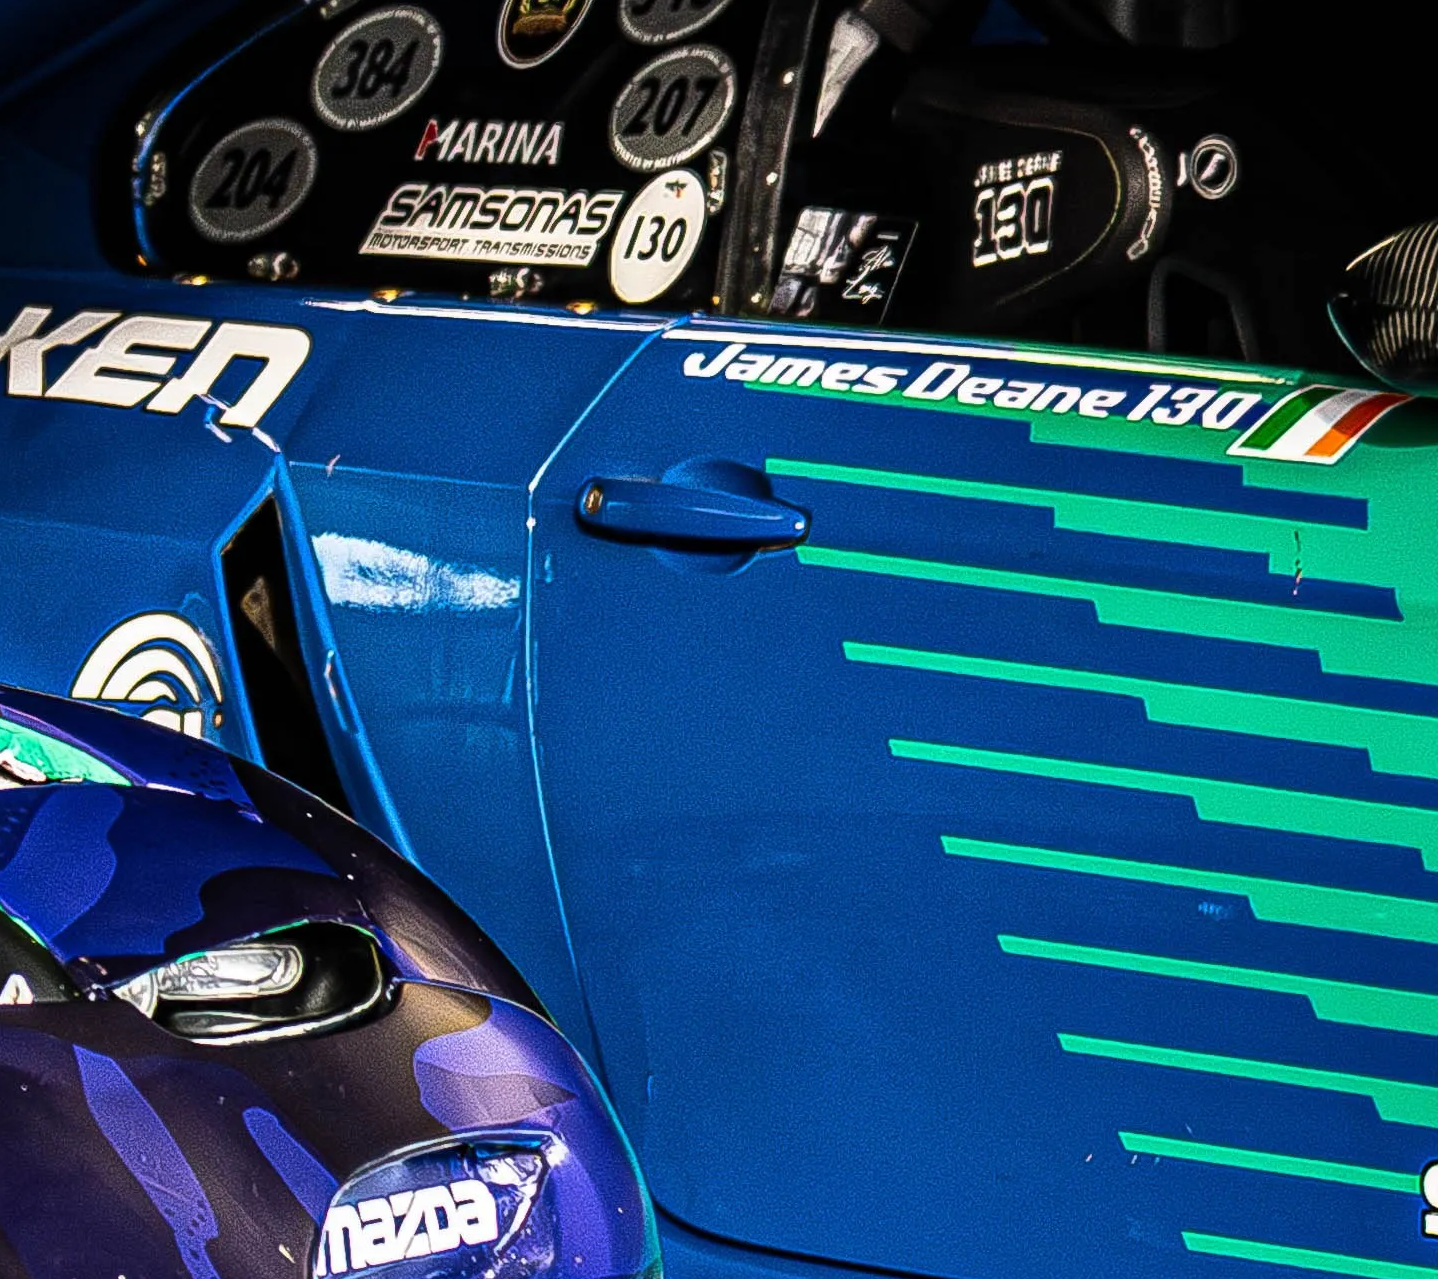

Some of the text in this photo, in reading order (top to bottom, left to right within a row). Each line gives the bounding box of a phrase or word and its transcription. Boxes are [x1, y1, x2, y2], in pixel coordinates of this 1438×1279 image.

[331, 37, 421, 100] 384
[621, 76, 721, 138] 207
[414, 119, 562, 166] MARINA
[204, 147, 299, 210] 204
[380, 185, 617, 234] SAMSONAS
[367, 232, 592, 260] MOTORSPORT TRANSMISSIONS
[623, 215, 687, 263] 130
[972, 177, 1055, 268] 130
[683, 342, 1263, 430] James Deane 130
